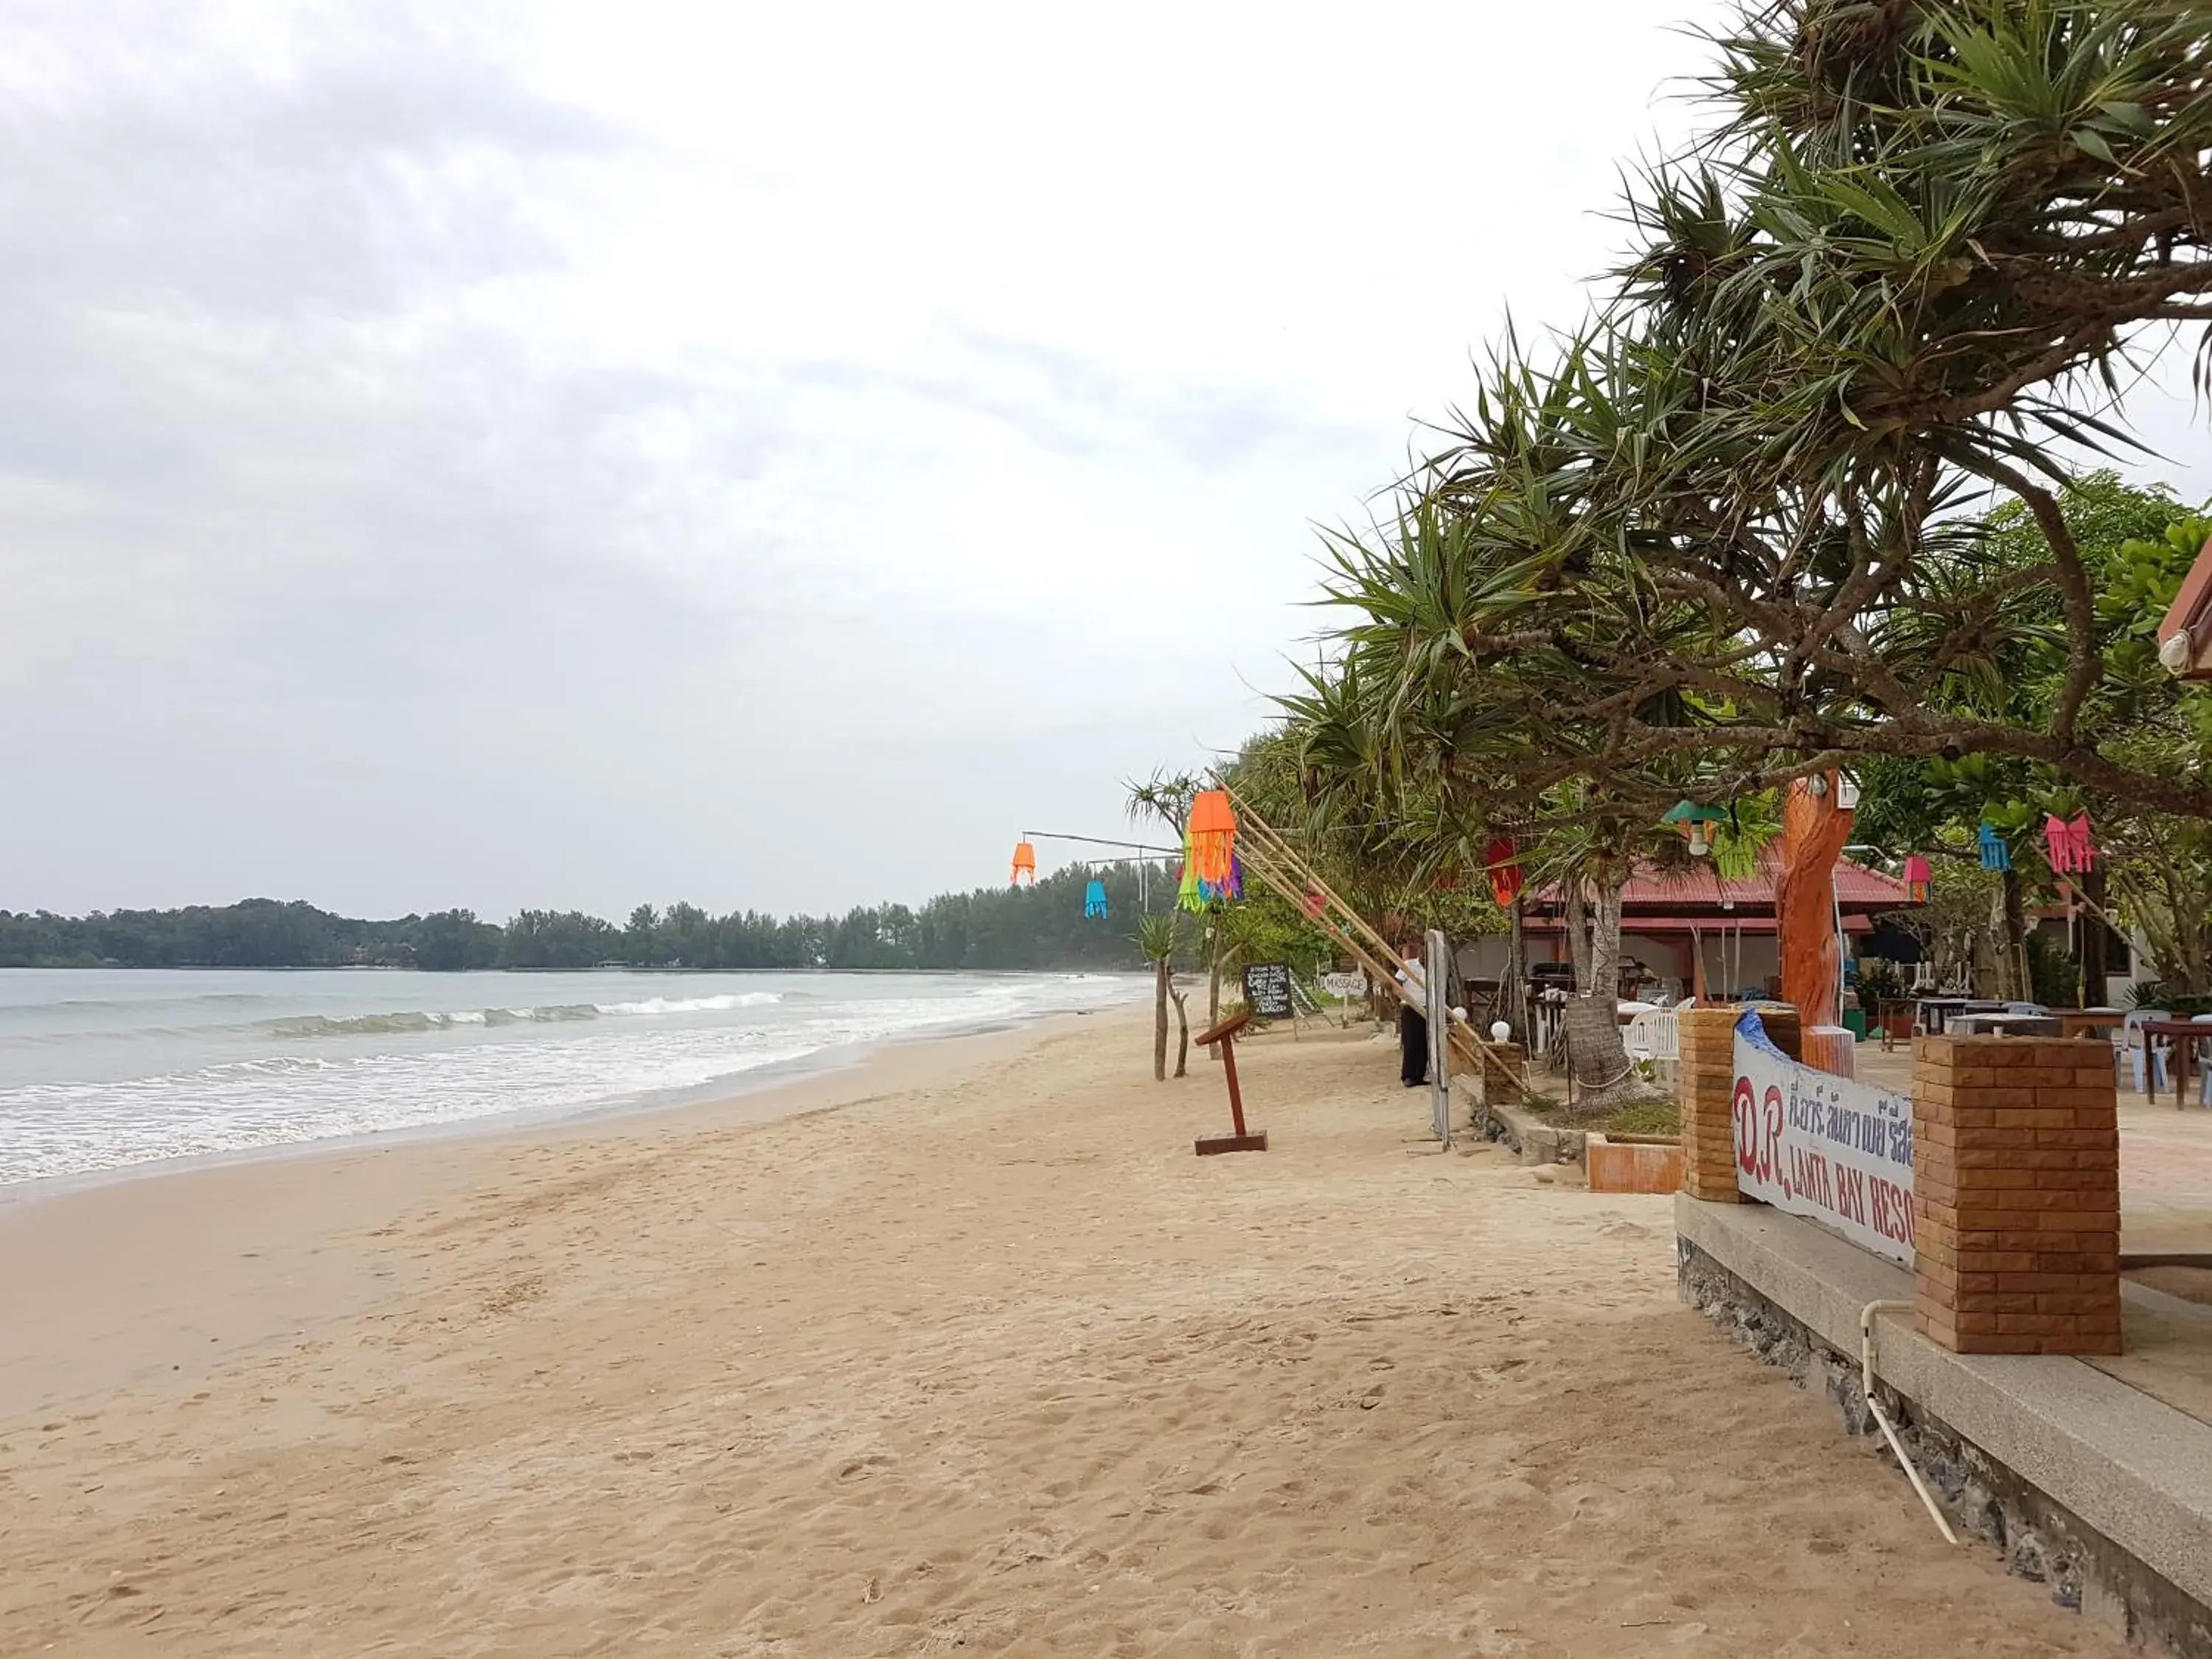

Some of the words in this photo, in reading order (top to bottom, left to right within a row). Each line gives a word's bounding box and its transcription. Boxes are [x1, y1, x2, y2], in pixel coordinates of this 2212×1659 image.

[1327, 978, 1364, 990] MASSAGE
[1790, 1144, 1834, 1211] LANTA
[1835, 1163, 1865, 1226] BAY
